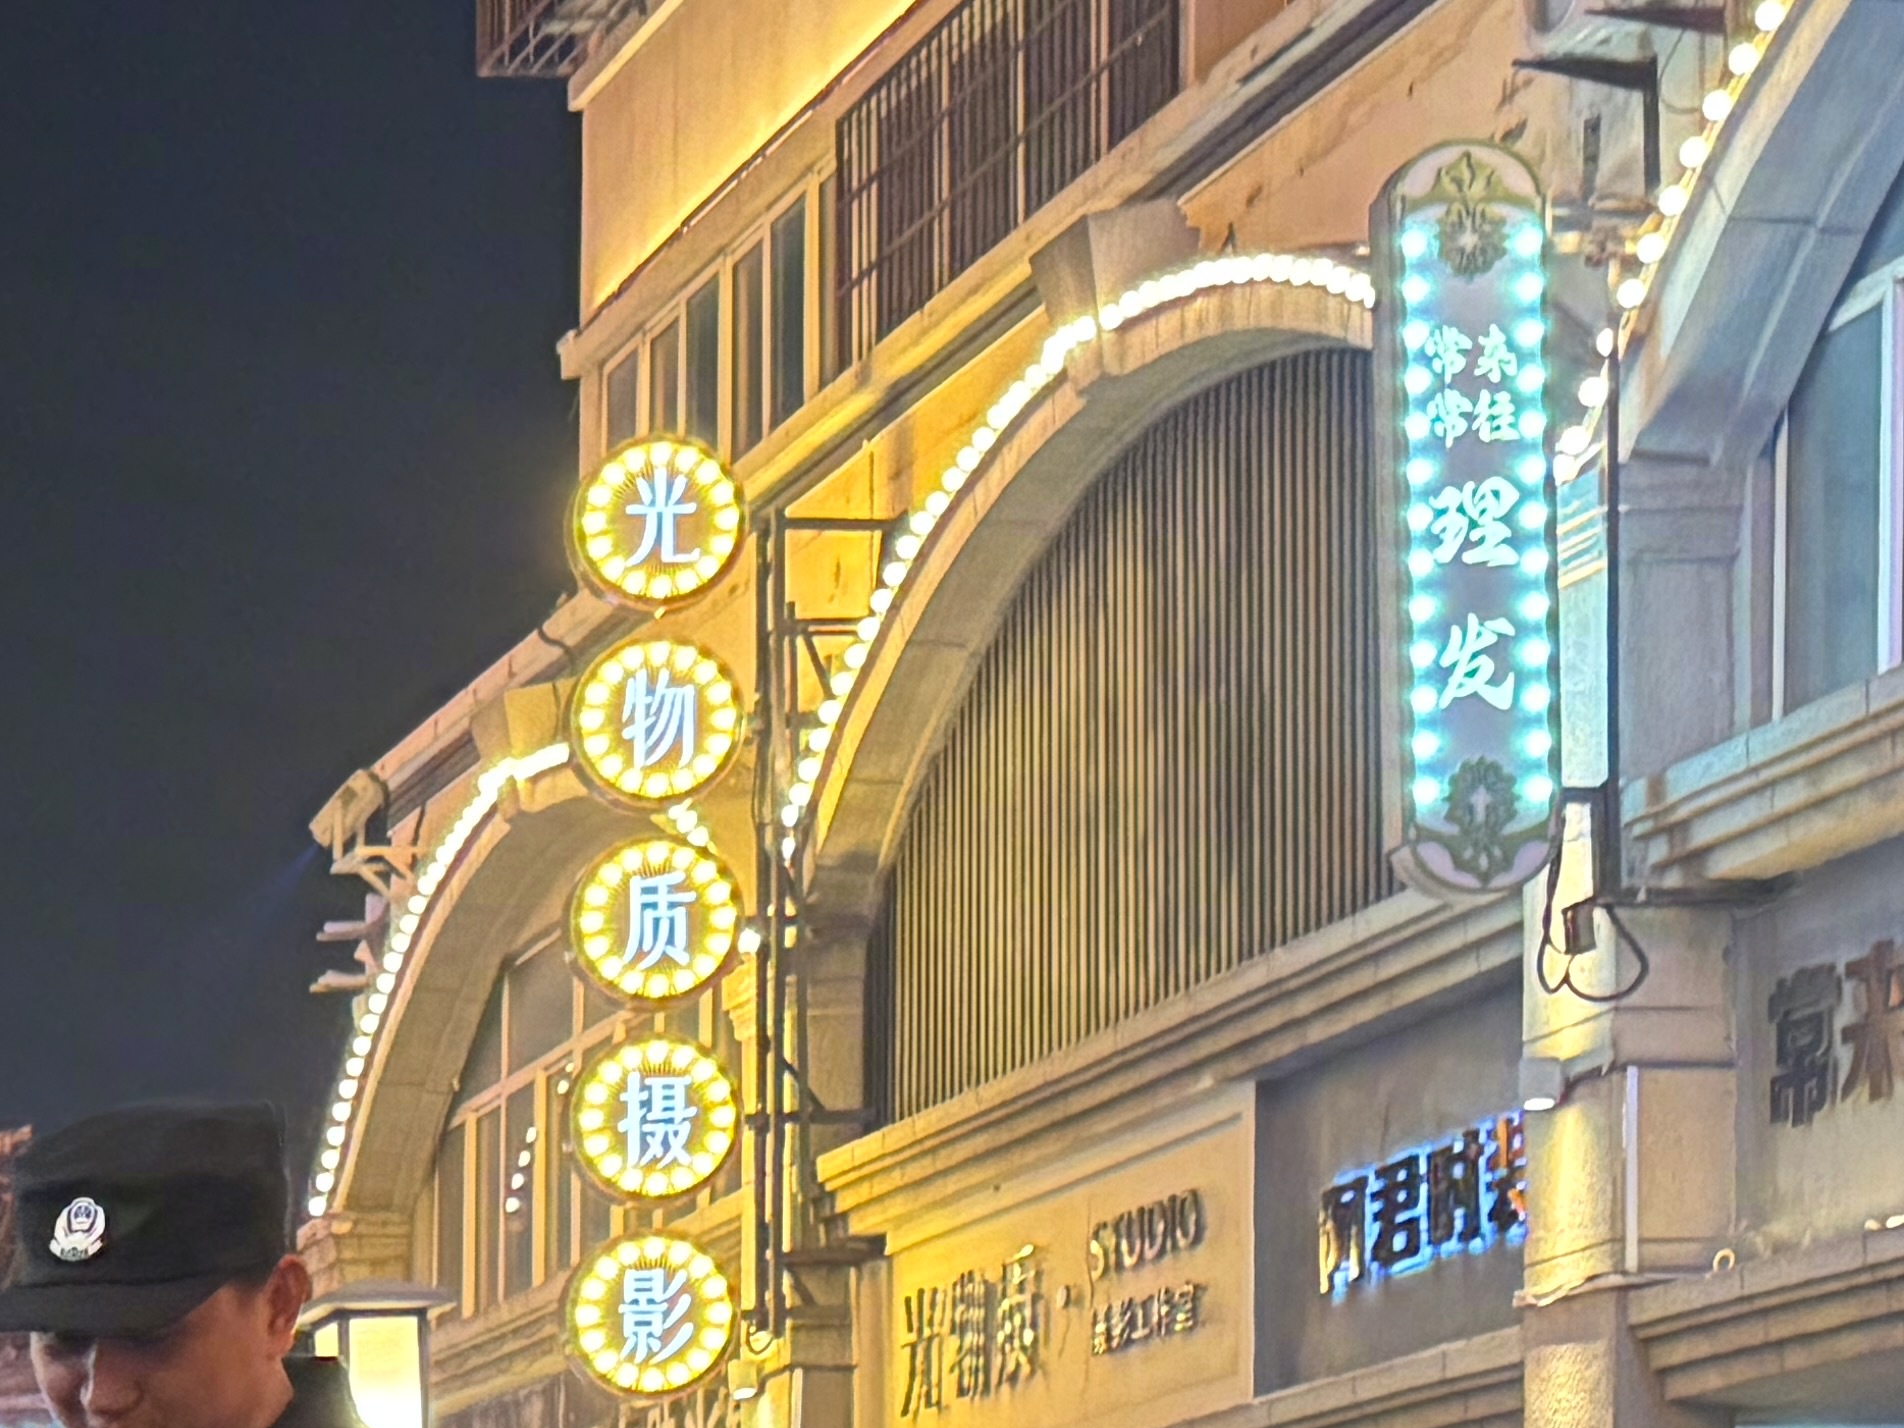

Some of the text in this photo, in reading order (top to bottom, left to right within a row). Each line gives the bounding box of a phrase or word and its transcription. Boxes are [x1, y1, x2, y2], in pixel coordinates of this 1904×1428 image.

[1428, 475, 1521, 711] 理发
[618, 468, 700, 1364] 光物质摄影
